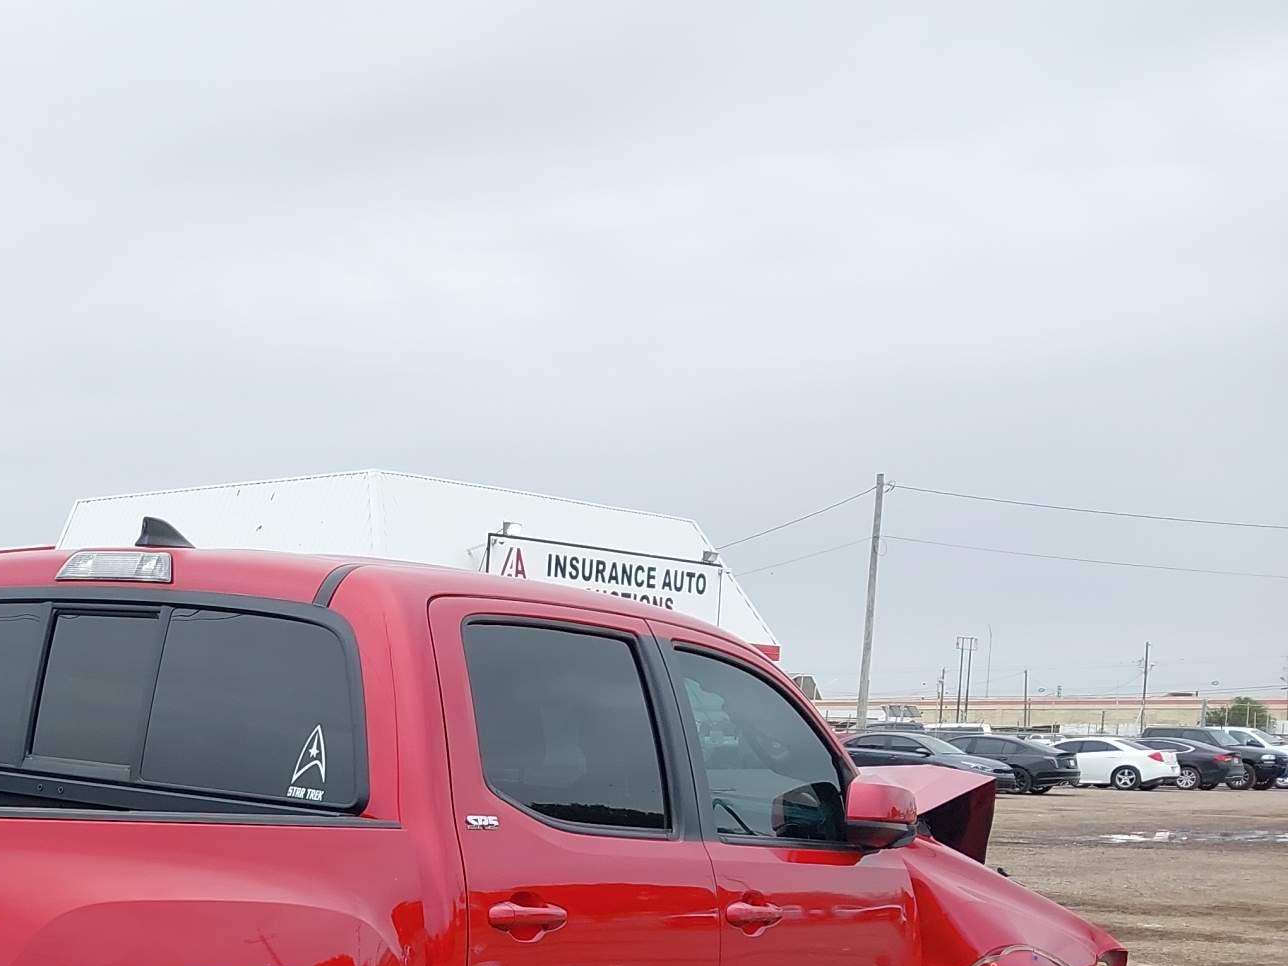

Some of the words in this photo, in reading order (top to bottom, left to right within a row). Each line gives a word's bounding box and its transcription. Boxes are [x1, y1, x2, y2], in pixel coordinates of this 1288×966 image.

[547, 554, 657, 588] INSURANCE
[662, 568, 707, 595] AUTO
[287, 785, 306, 799] STAR
[306, 788, 324, 801] TREK
